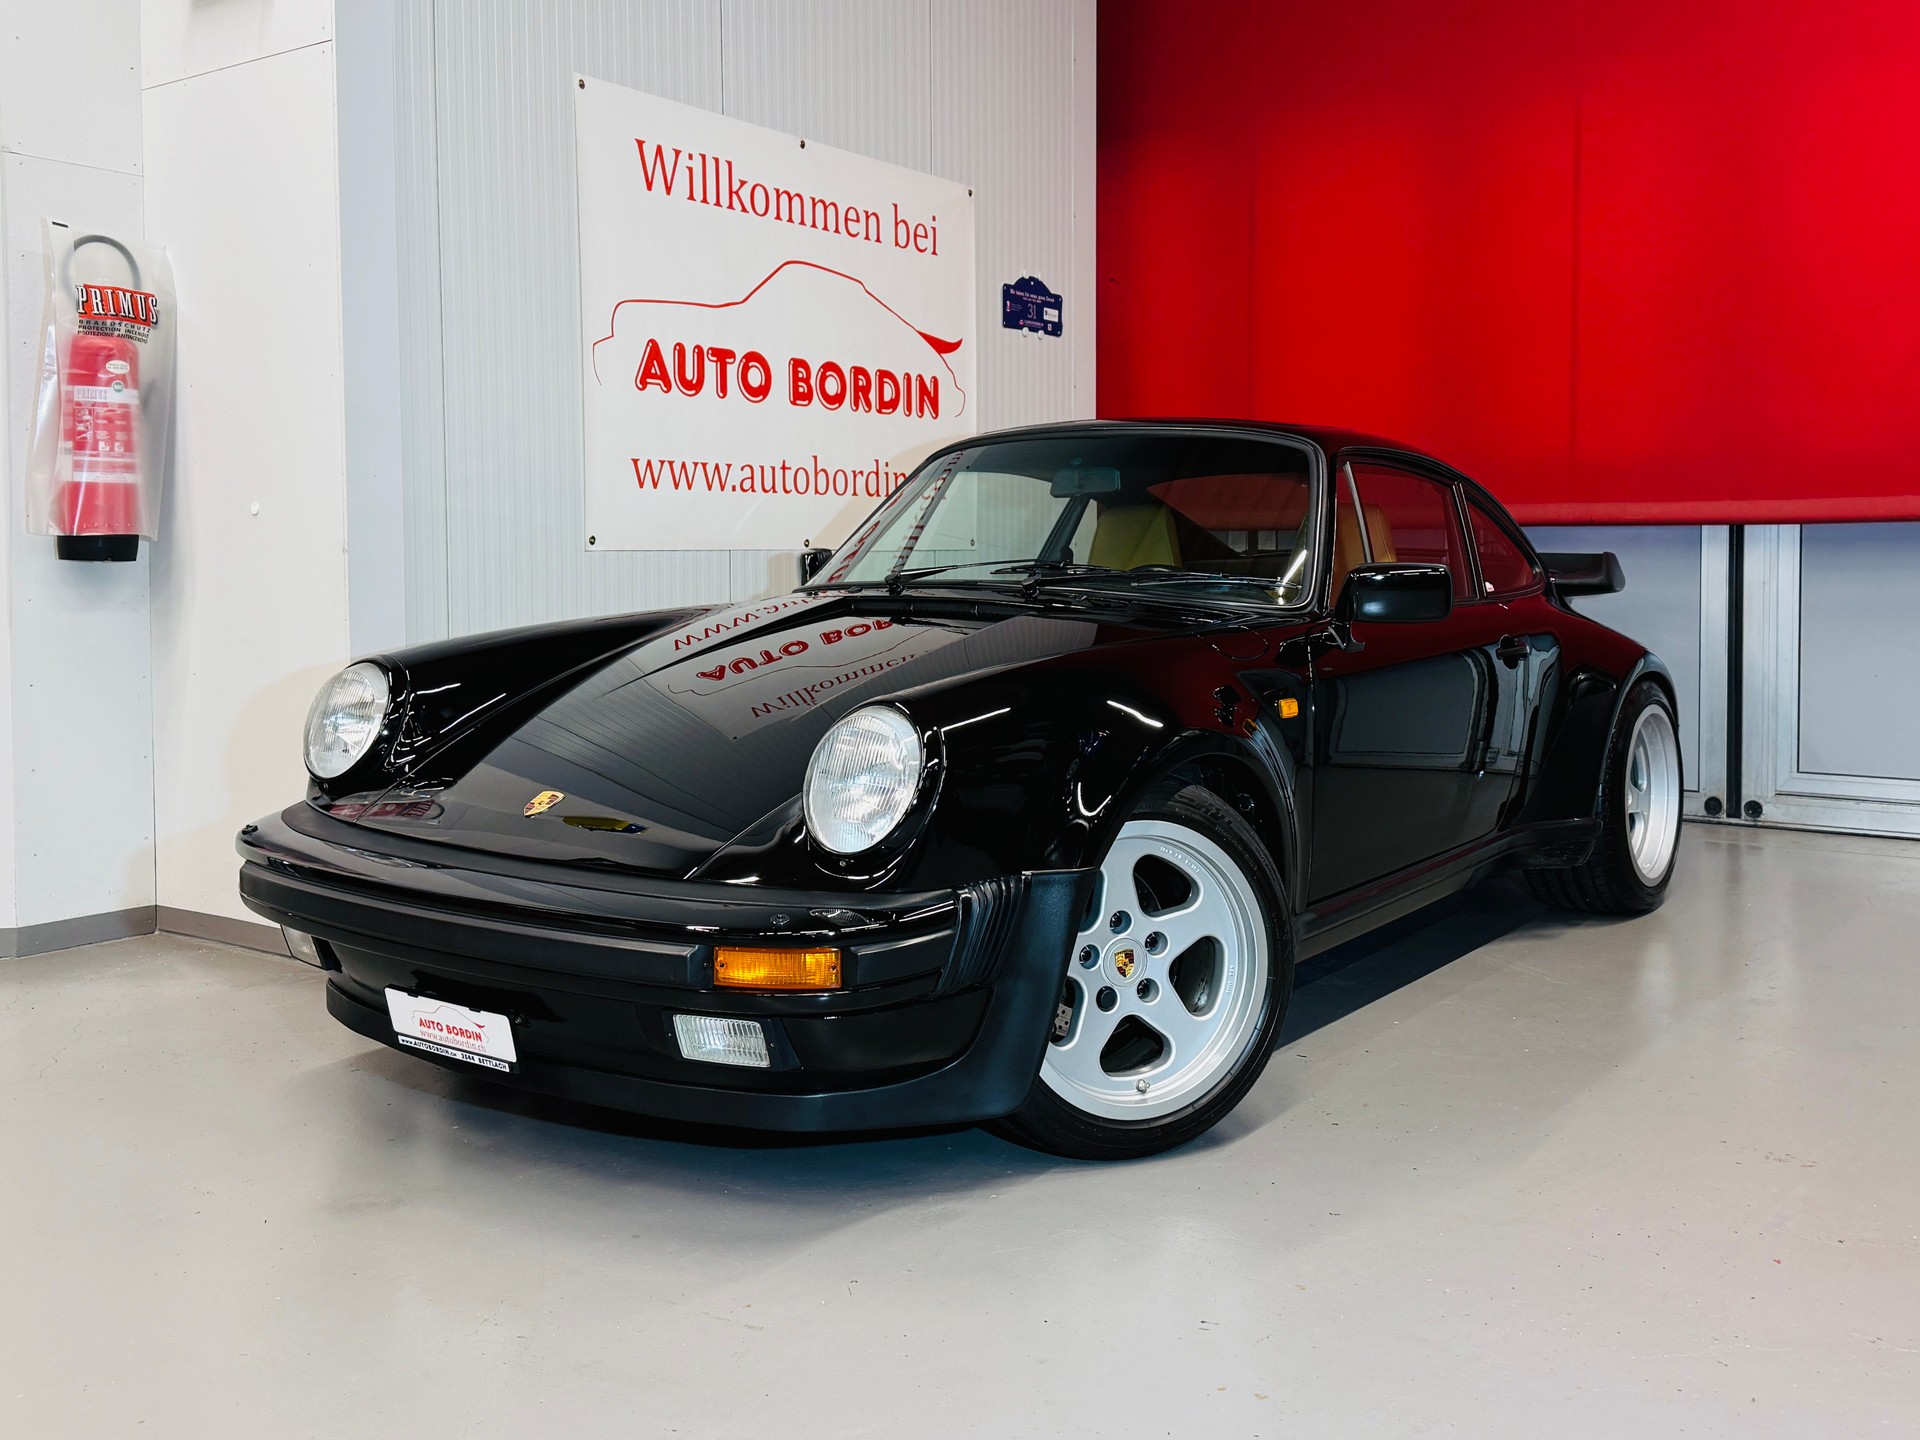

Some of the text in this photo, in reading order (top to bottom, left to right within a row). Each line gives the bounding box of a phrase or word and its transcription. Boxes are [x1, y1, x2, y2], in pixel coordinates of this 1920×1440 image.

[634, 138, 939, 256] Willkommen bei
[75, 285, 158, 326] PRIMUS
[1027, 303, 1036, 319] 31
[79, 319, 151, 333] BRANDSCHUTZ
[125, 328, 149, 338] INCENDIE
[77, 330, 148, 344] PROTEZIONE ANTINCENDIO
[634, 338, 940, 420] AUTO BORDIN
[419, 1018, 482, 1042] AUTO BORDIN
[420, 1030, 486, 1053] www.autobordin.ch
[478, 1057, 507, 1070] BETTLACH
